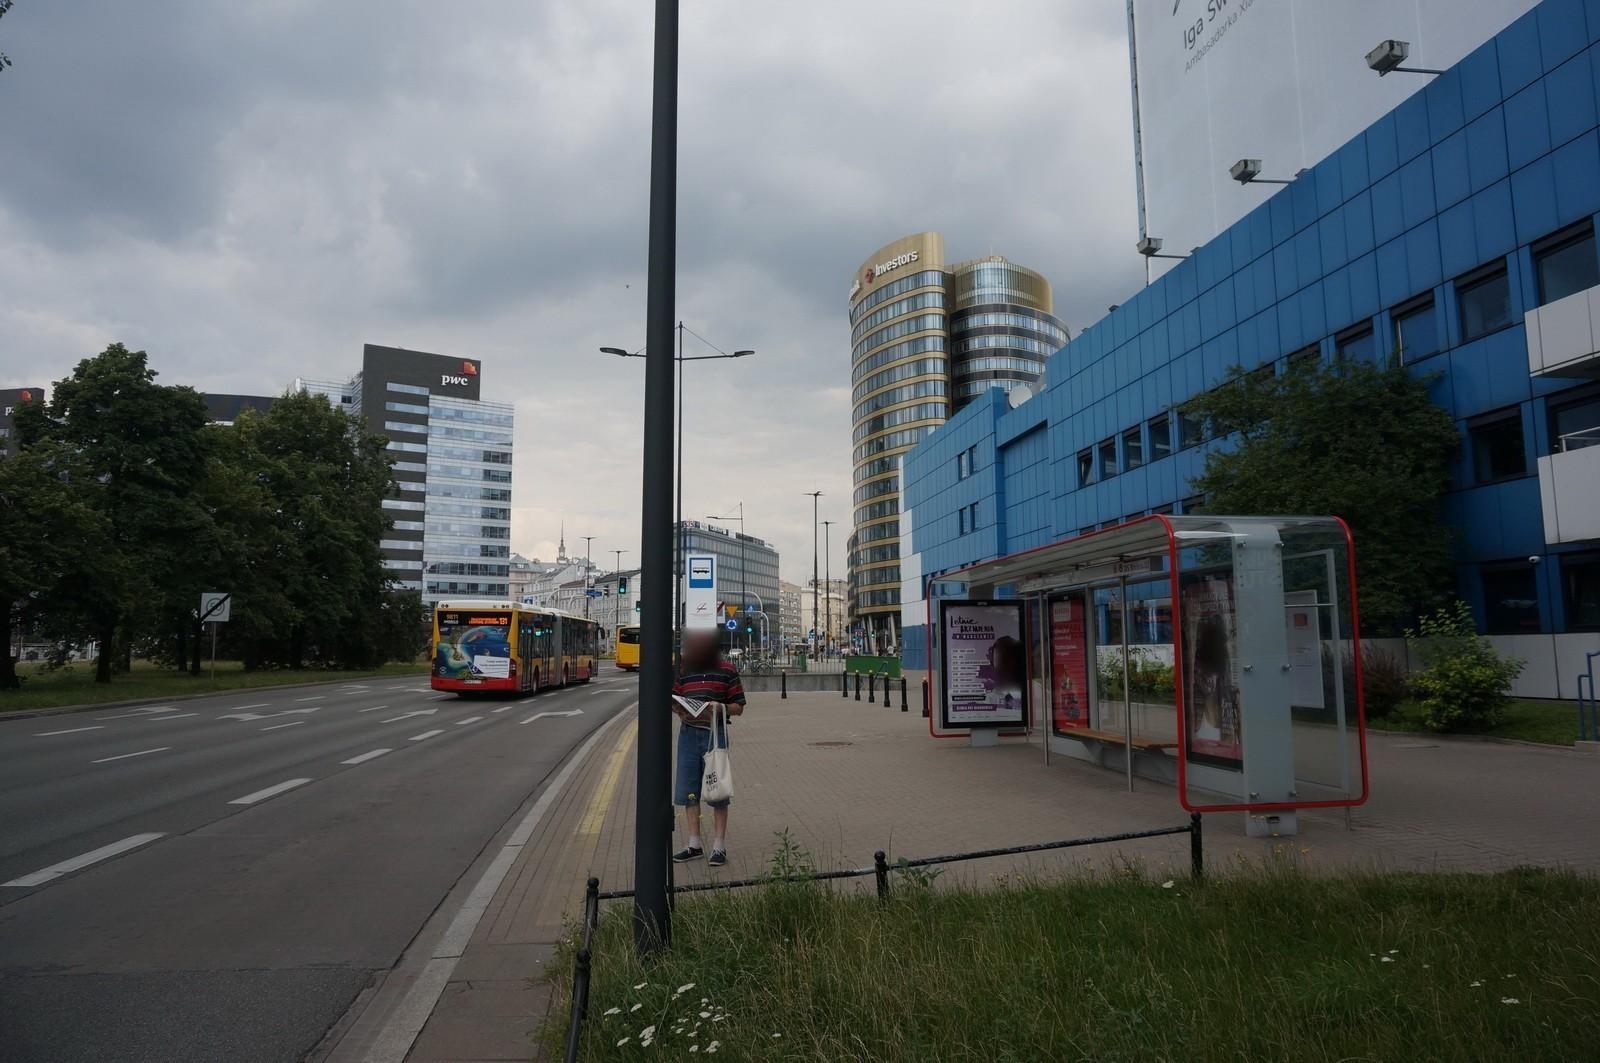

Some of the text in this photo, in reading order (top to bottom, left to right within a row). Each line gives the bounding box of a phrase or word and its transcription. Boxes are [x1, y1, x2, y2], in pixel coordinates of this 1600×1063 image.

[1184, 17, 1204, 50] Iga
[1185, 12, 1238, 74] Ambasadorka
[875, 250, 919, 277] Investors
[441, 374, 468, 386] pwc
